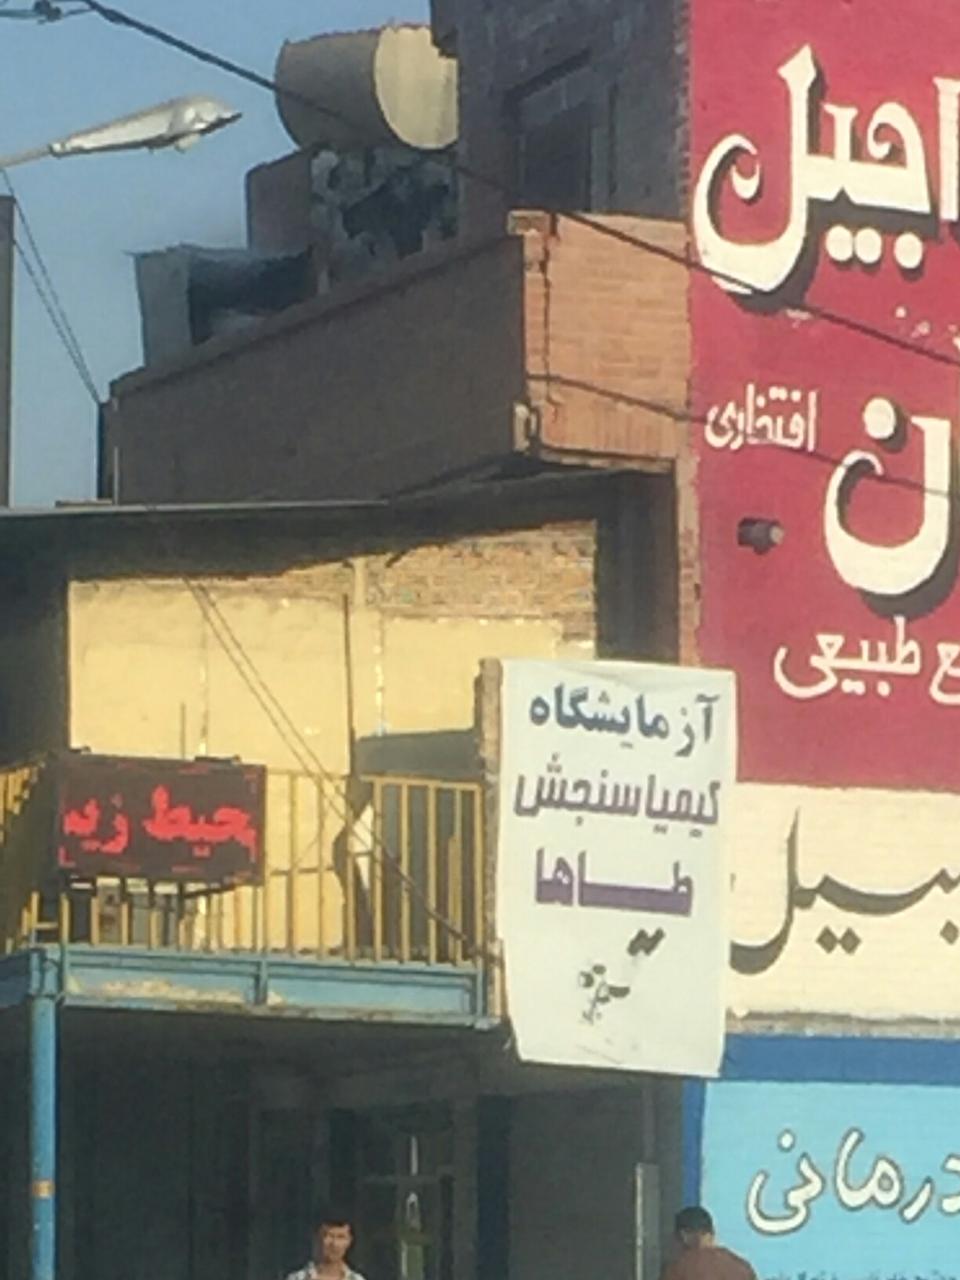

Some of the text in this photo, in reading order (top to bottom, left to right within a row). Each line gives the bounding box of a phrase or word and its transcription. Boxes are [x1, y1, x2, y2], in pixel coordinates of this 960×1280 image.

[704, 383, 818, 453] افتخاری
[773, 615, 921, 699] طبیعی
[529, 682, 721, 758] آزمایشگاه
